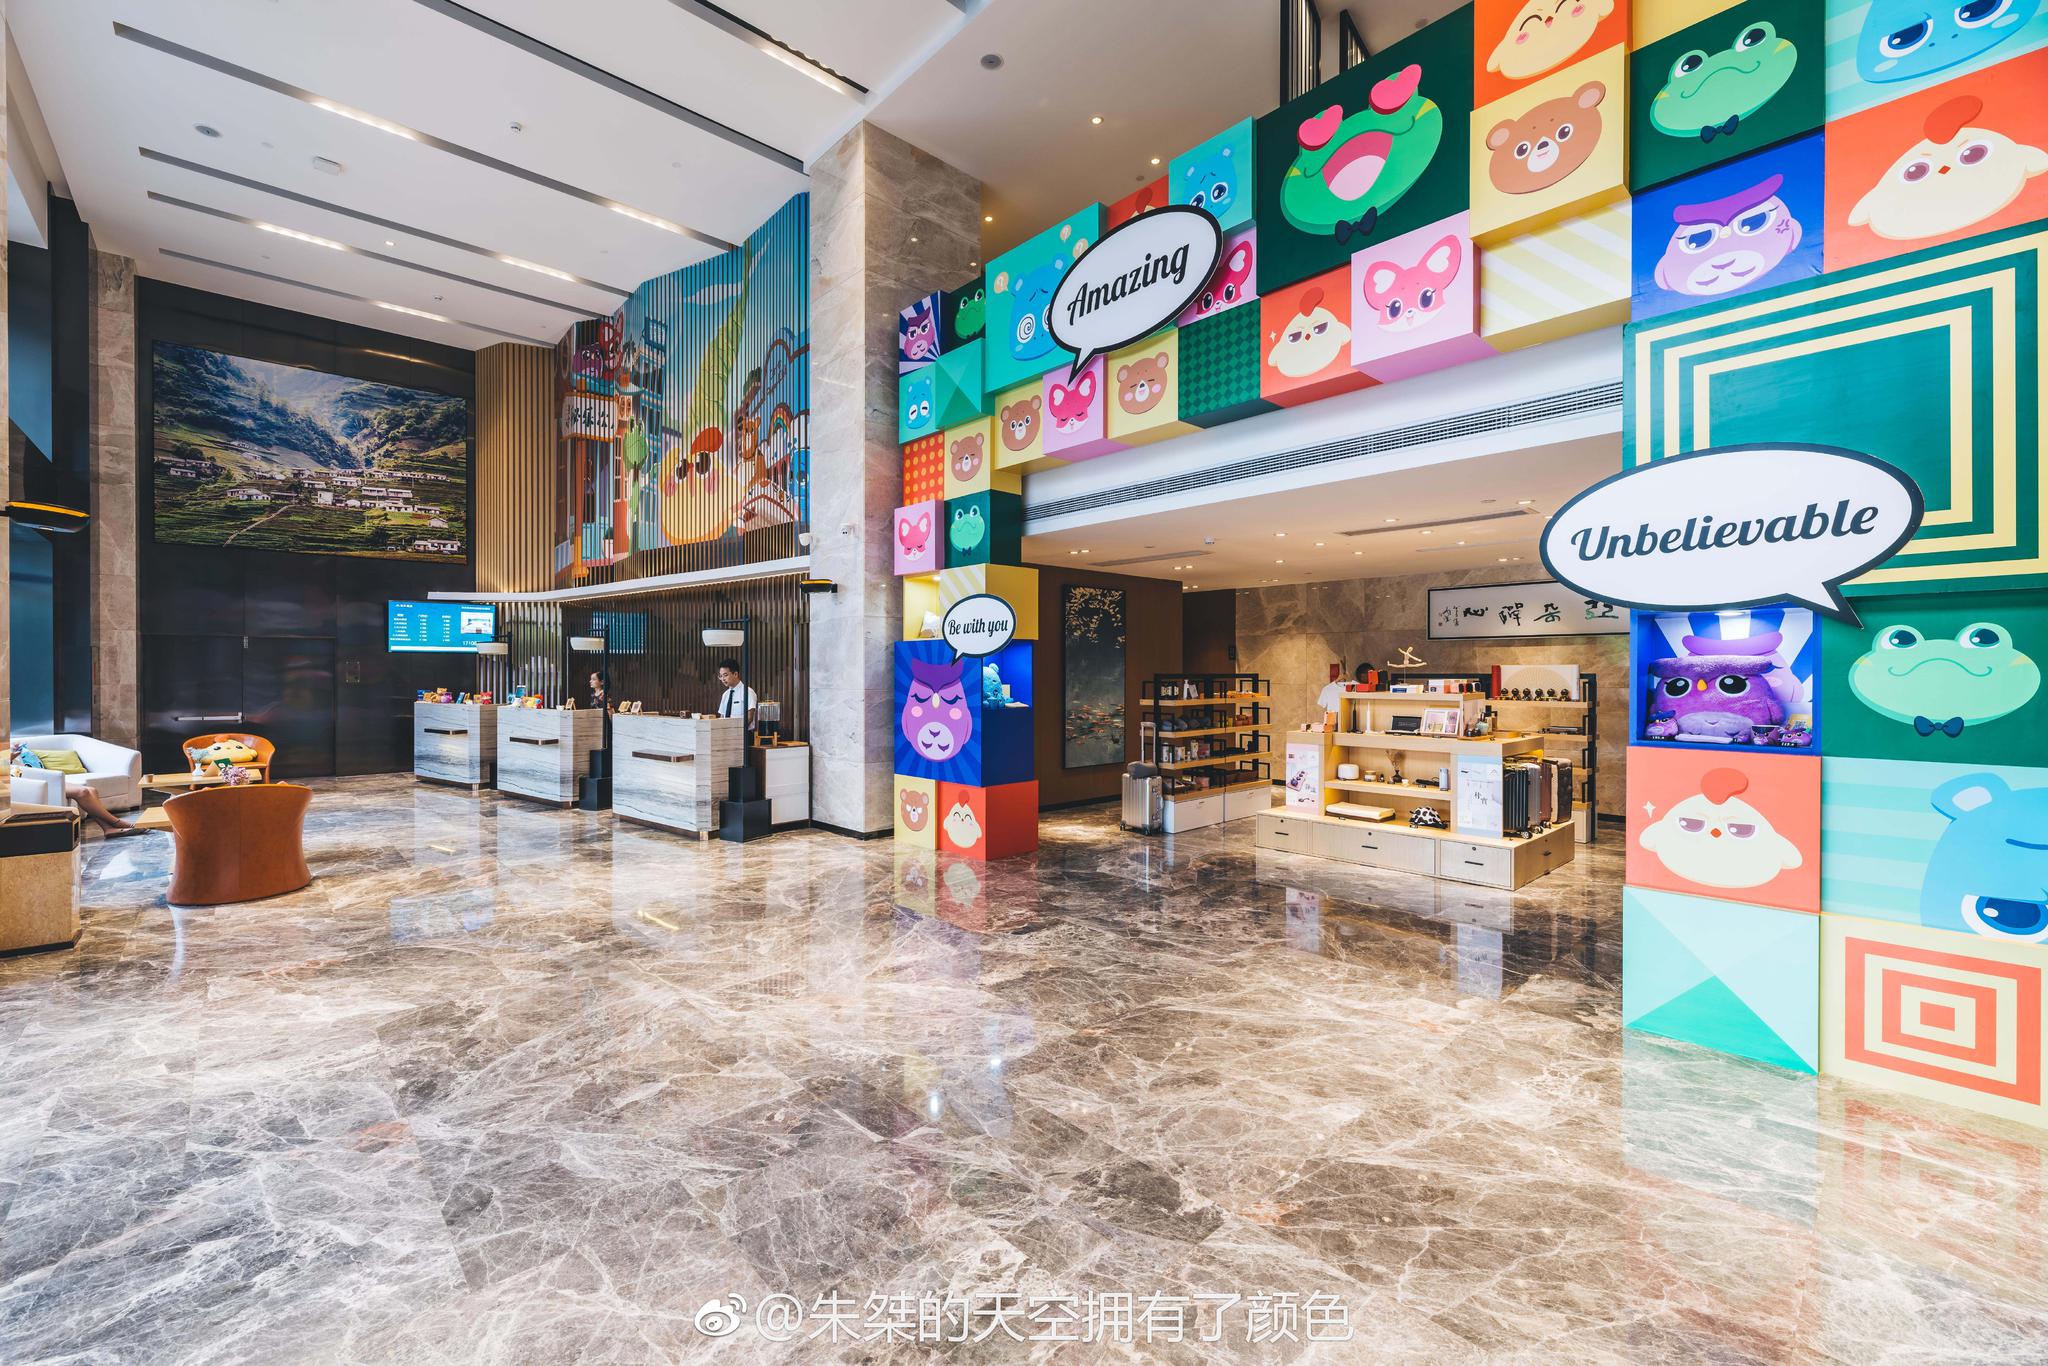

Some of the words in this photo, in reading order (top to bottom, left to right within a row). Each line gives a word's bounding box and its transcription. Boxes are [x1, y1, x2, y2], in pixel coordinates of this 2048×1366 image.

[1067, 243, 1190, 326] Amazing
[1570, 499, 1879, 562] Unbelievable
[947, 619, 962, 635] Be
[963, 618, 986, 634] with
[987, 619, 1009, 637] you
